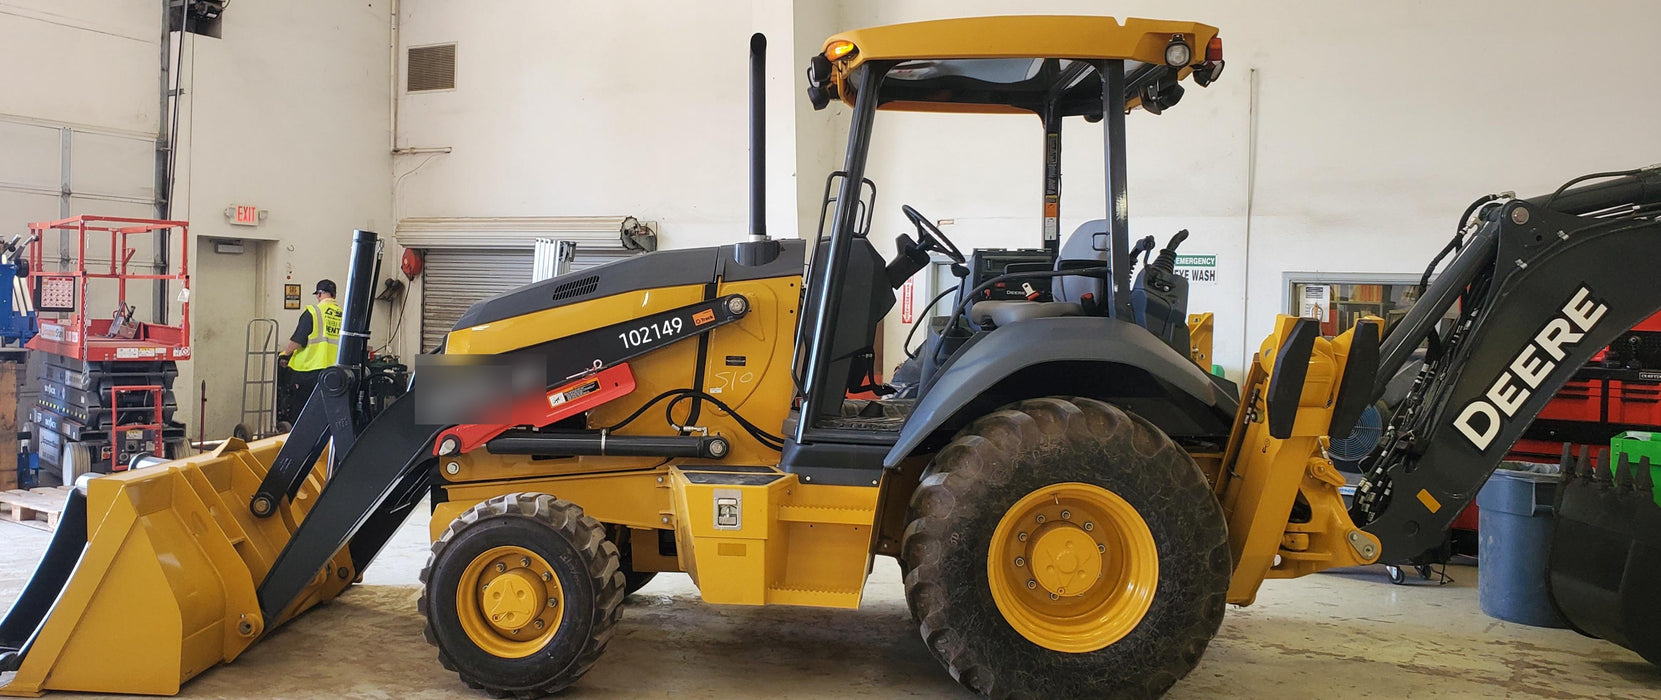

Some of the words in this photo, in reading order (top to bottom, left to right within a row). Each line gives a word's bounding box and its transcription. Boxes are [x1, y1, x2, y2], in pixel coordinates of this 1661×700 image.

[237, 205, 256, 222] EXIT
[1176, 257, 1215, 265] EMERGENCY
[1191, 270, 1216, 281] WASH
[618, 317, 683, 349] 102149
[1453, 286, 1608, 451] DEERE
